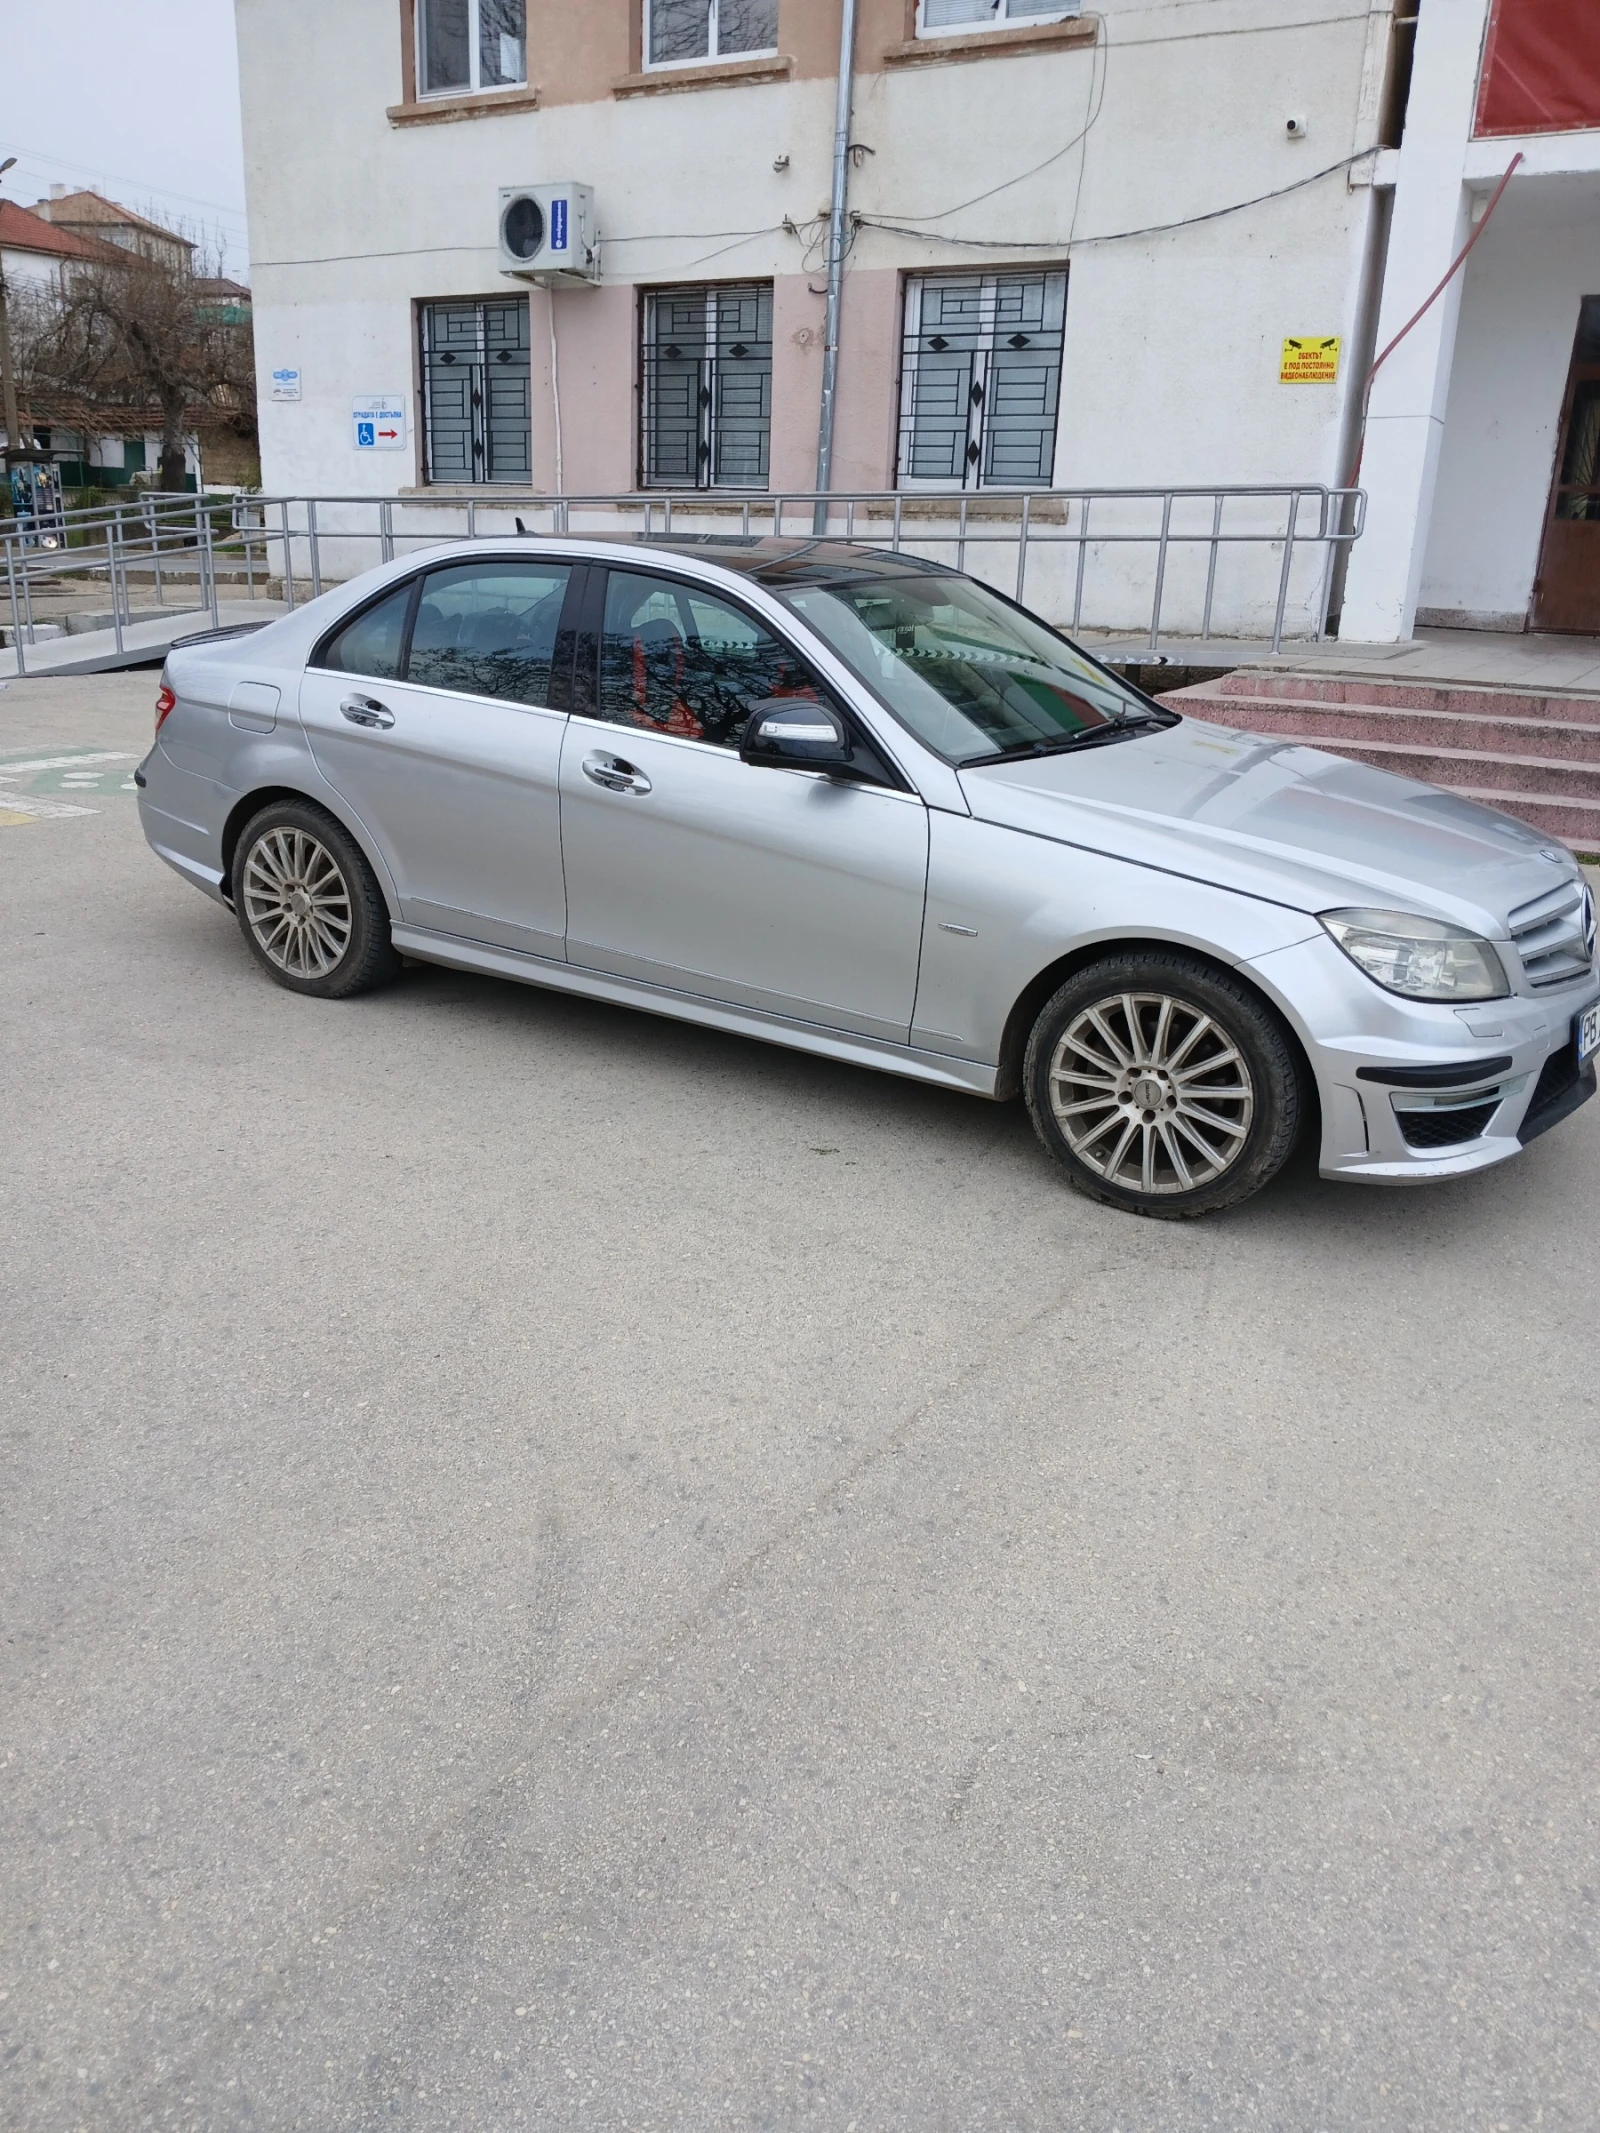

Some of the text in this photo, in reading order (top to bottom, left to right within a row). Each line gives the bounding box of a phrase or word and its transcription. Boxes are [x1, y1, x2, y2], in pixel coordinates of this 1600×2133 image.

[1298, 352, 1322, 360] ОБЕКТЪТ
[1289, 362, 1300, 370] ПОД
[1301, 362, 1334, 370] ПОСТОЯННО
[1281, 371, 1335, 380] ВИДЕОНАБЛЮДЕНИЕ
